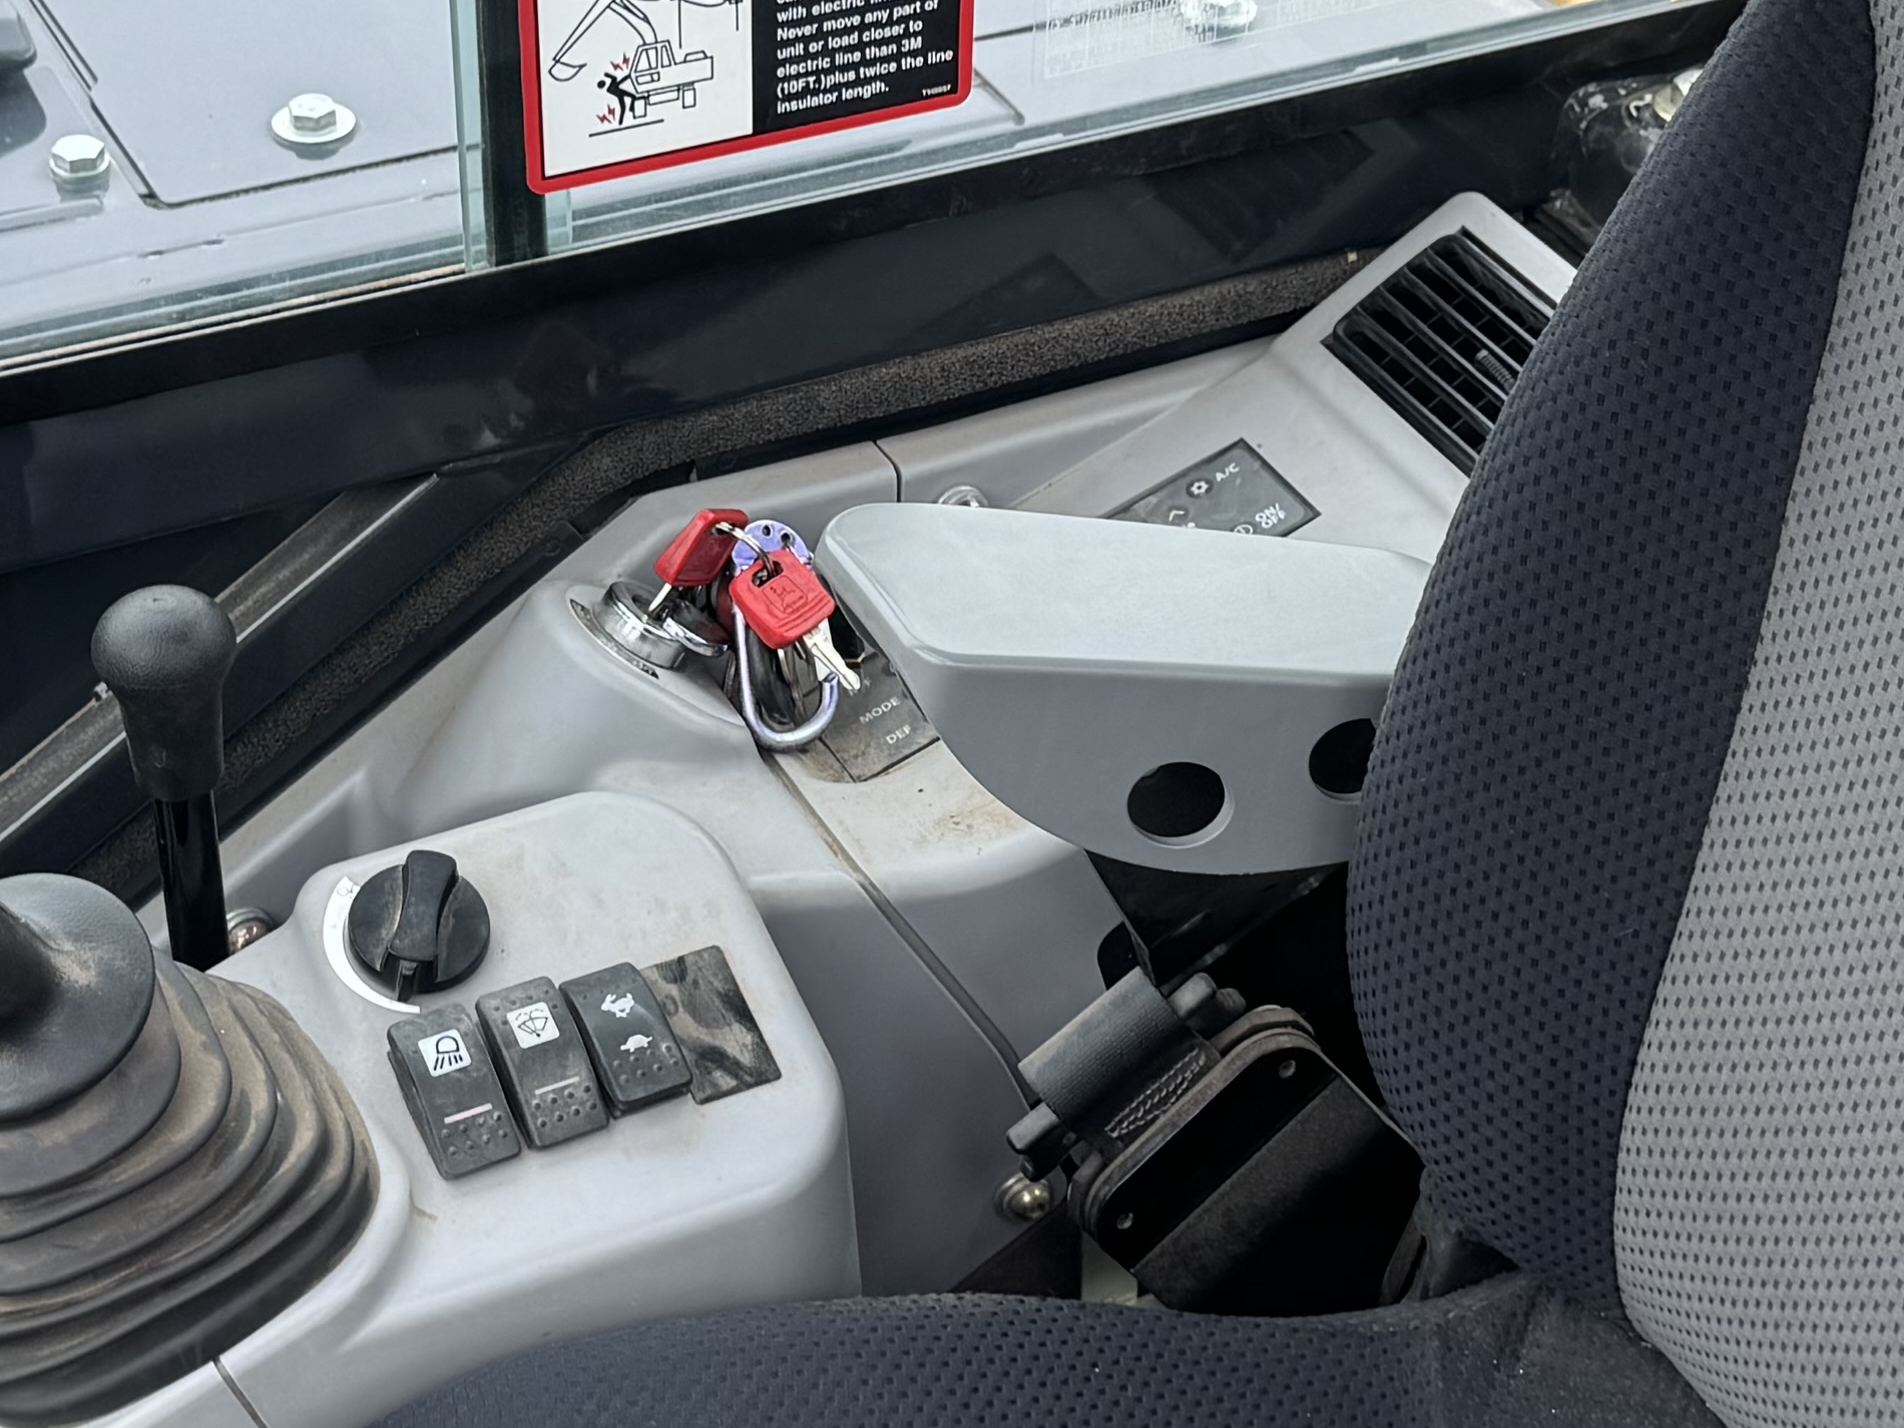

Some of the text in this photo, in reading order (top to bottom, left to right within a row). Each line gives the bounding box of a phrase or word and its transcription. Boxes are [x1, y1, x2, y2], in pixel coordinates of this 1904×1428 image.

[777, 6, 807, 23] with
[777, 22, 818, 41] Never
[823, 16, 861, 32] move
[864, 7, 889, 25] any
[893, 1, 920, 20] part
[777, 19, 923, 60] unit or load closer to
[777, 36, 923, 78] electric line than 3M
[859, 62, 897, 79] twice
[901, 56, 923, 70] the
[927, 49, 954, 65] line
[777, 84, 890, 114] insulator length.
[1215, 462, 1240, 482] A/C
[859, 696, 901, 724] MODE
